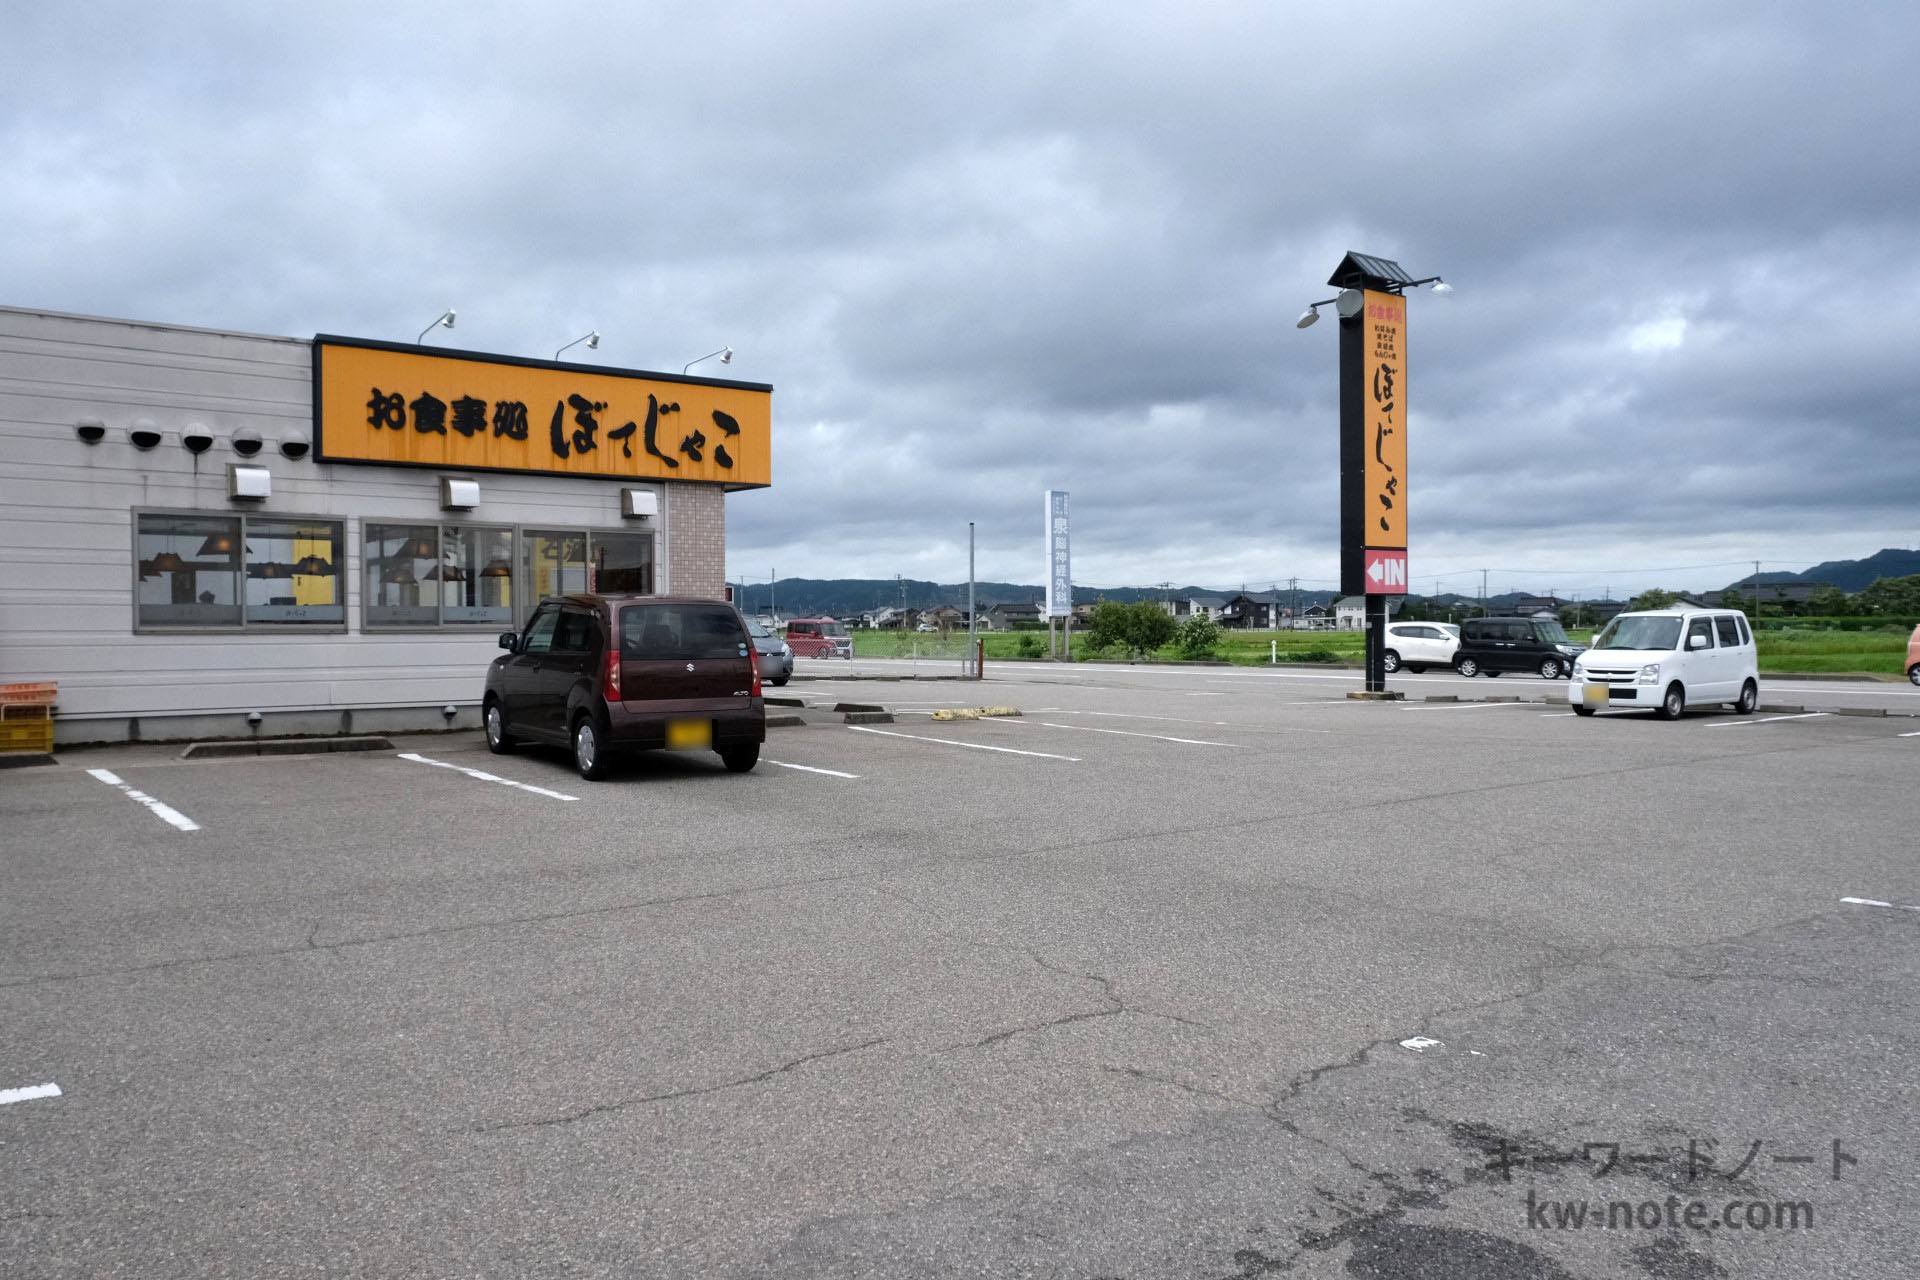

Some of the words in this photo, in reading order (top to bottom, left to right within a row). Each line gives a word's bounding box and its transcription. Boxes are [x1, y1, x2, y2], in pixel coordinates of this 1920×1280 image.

[366, 387, 529, 441] お食事処
[550, 393, 741, 468] ぼてじゃこ
[1384, 559, 1405, 586] IN
